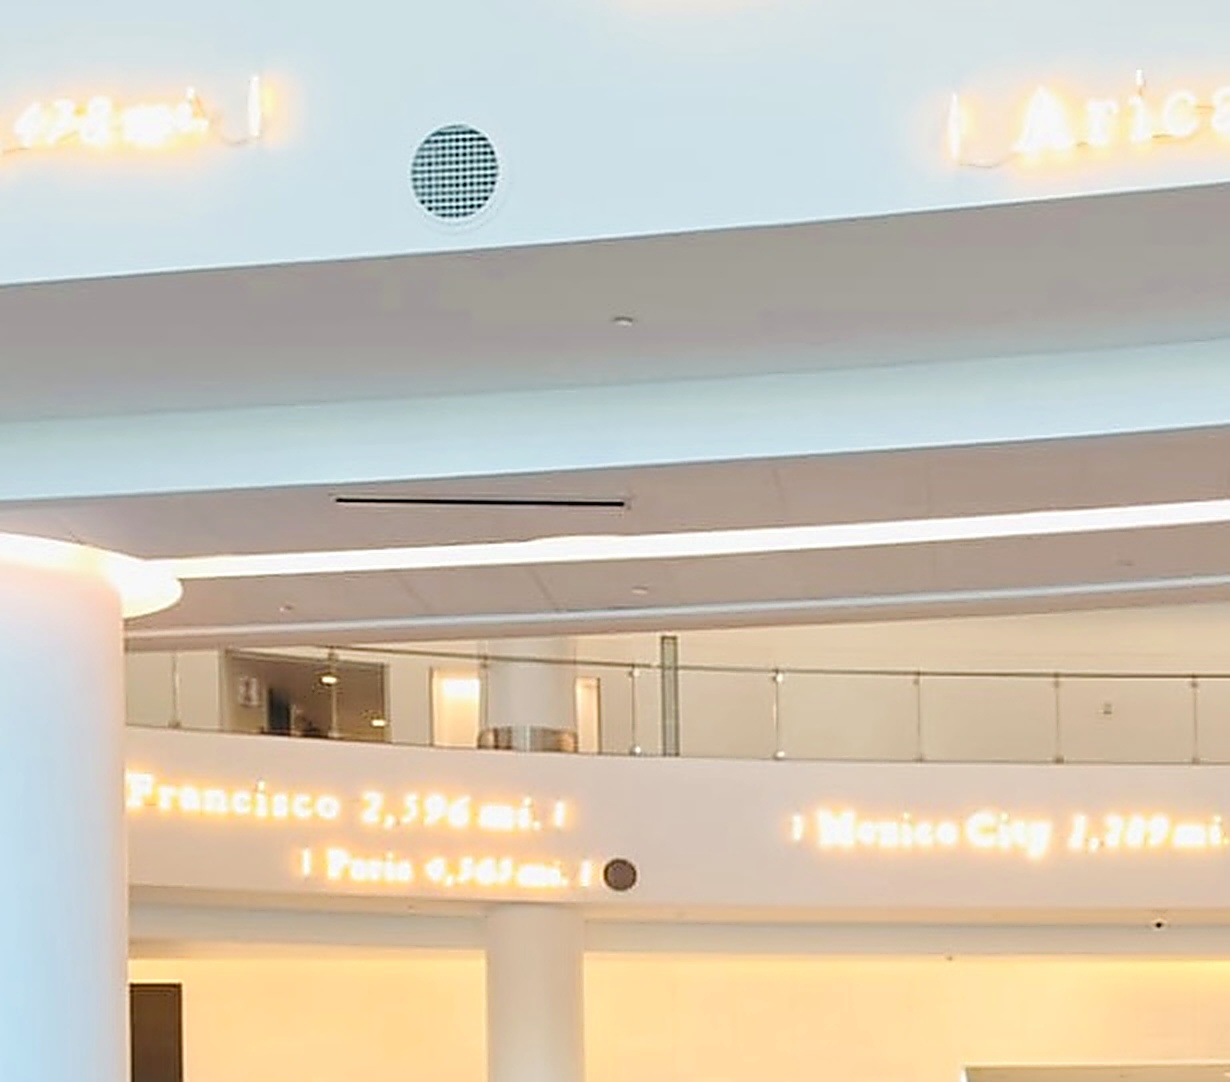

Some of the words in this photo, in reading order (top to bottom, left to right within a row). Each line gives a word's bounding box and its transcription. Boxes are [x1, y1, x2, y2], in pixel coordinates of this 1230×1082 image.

[125, 772, 340, 820] Francisco
[361, 790, 472, 829] 2,596
[816, 808, 958, 847] Mexico
[966, 811, 1052, 860] City
[326, 847, 413, 882] Paris
